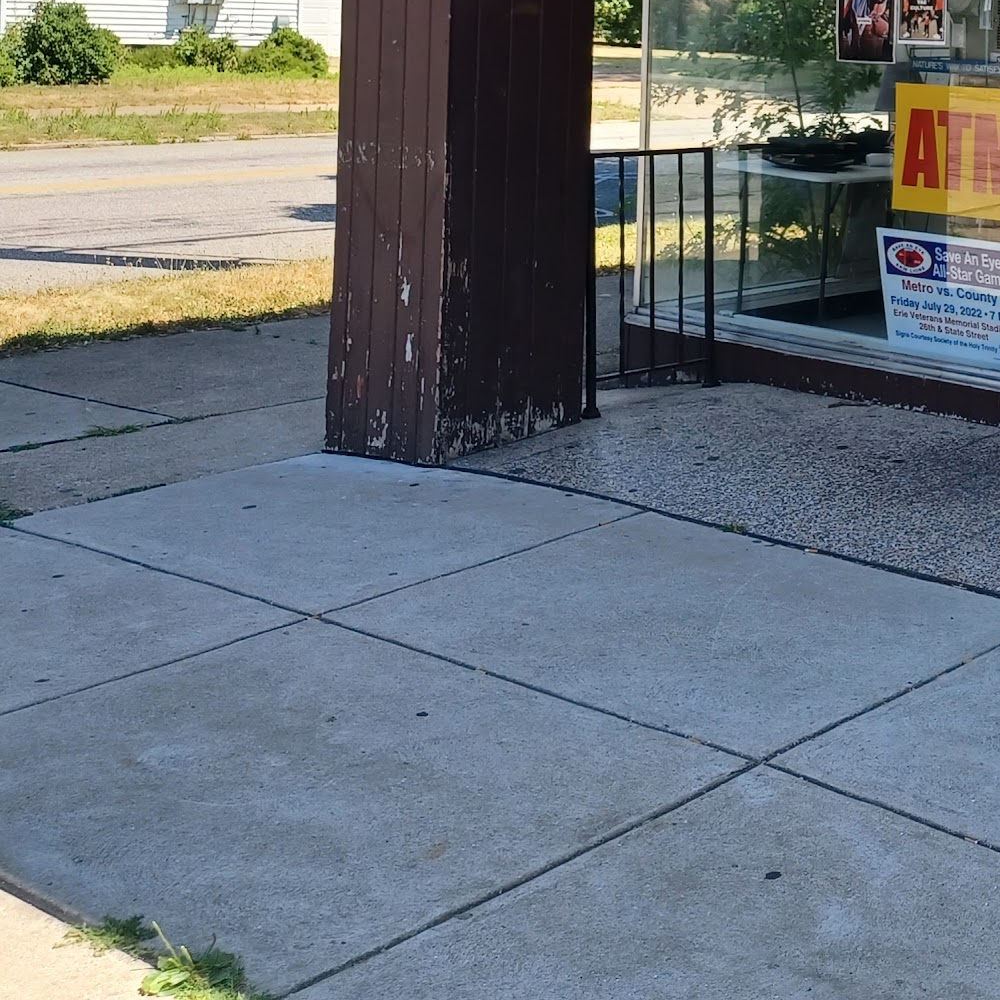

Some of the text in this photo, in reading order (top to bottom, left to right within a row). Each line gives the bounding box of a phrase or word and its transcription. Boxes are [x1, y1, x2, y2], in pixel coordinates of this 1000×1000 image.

[912, 60, 943, 70] NATURE'S
[935, 247, 961, 264] Save
[964, 251, 979, 266] An
[932, 263, 973, 282] All-Star
[902, 280, 998, 305] Metro vs. County
[891, 296, 919, 310] Friday
[922, 301, 941, 315] July
[944, 303, 958, 315] 29,
[960, 306, 982, 318] 2022
[989, 311, 996, 320] 7
[893, 309, 908, 318] Erie
[910, 311, 943, 324] Veterans
[945, 316, 980, 330] Memorial
[896, 330, 910, 339] Signs
[911, 332, 933, 343] Courtesy
[934, 336, 952, 346] Society
[969, 342, 980, 350] Holy
[981, 344, 998, 354] Trinity
[919, 323, 989, 341] 26th & State Street
